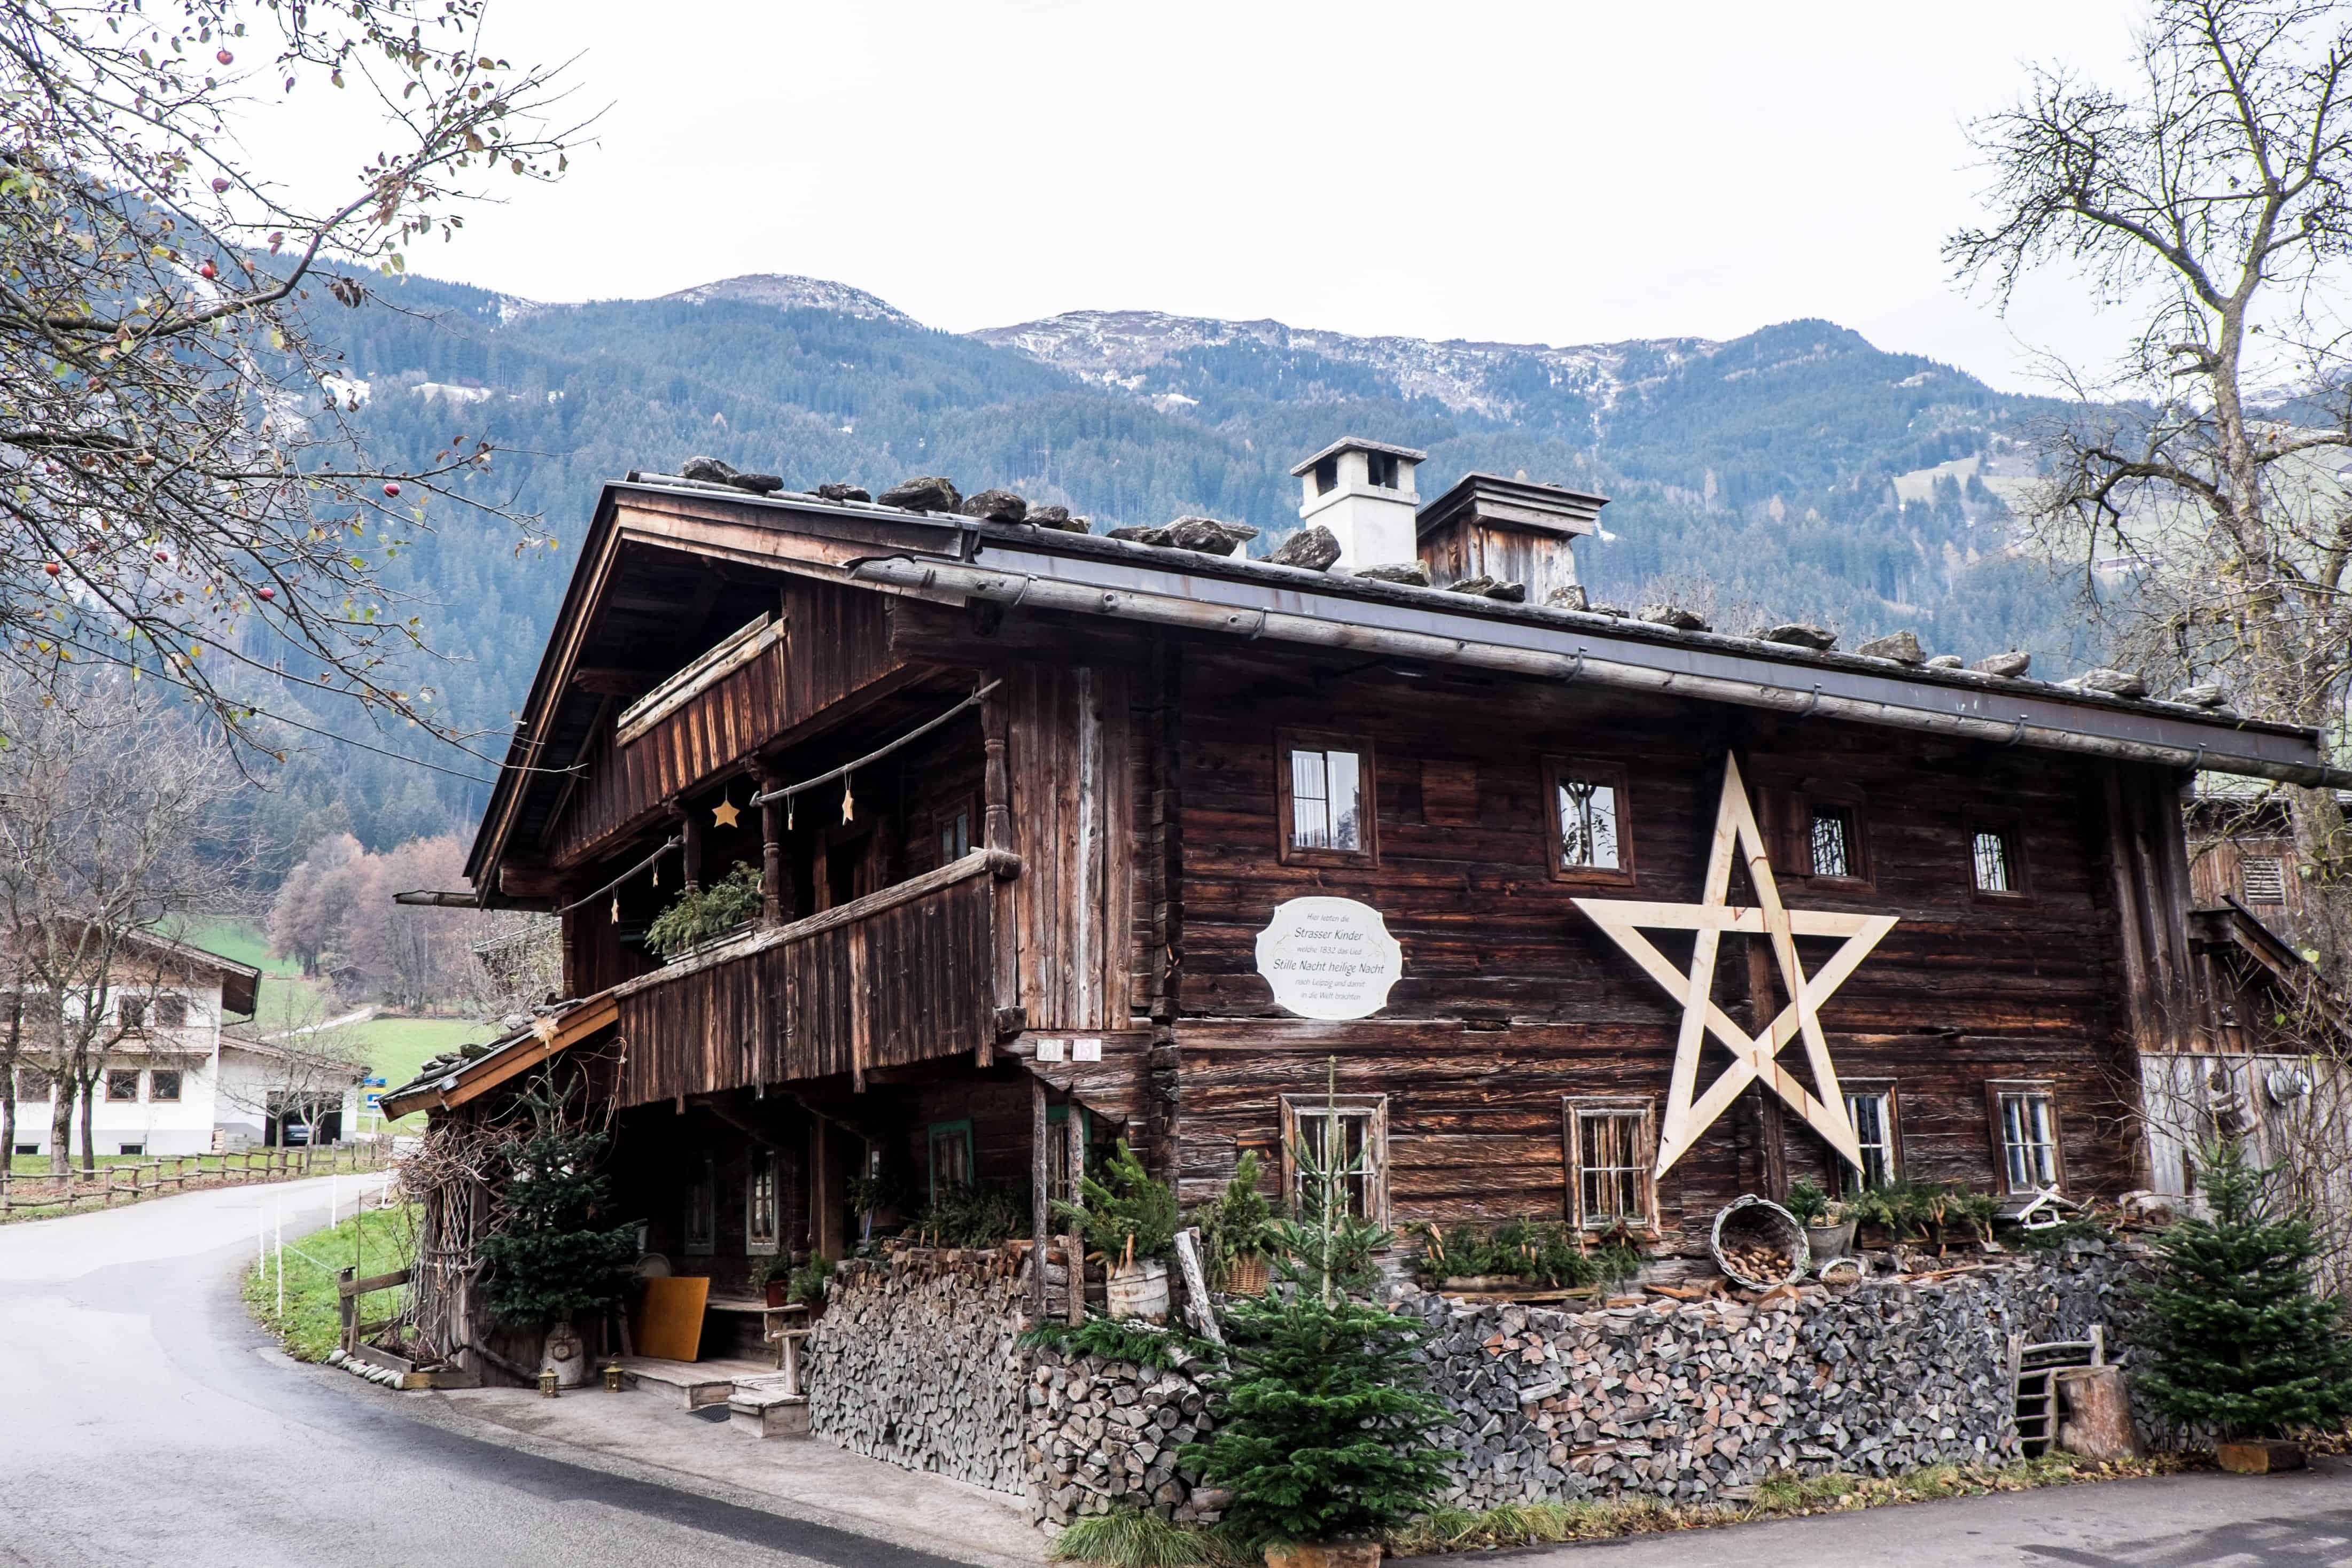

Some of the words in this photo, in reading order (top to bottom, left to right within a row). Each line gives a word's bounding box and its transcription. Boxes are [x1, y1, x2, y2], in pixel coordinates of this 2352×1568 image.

[1321, 914, 1339, 922] lebten
[1341, 915, 1350, 923] die
[1295, 927, 1333, 939] Strasser
[1334, 930, 1364, 941] Kinder
[1273, 958, 1297, 970] Stille
[1299, 960, 1327, 971] Nacht
[1329, 961, 1356, 976] heilige
[1359, 963, 1385, 974] Nacht
[1312, 979, 1333, 989] Leipzig
[1335, 993, 1361, 1001] brachten
